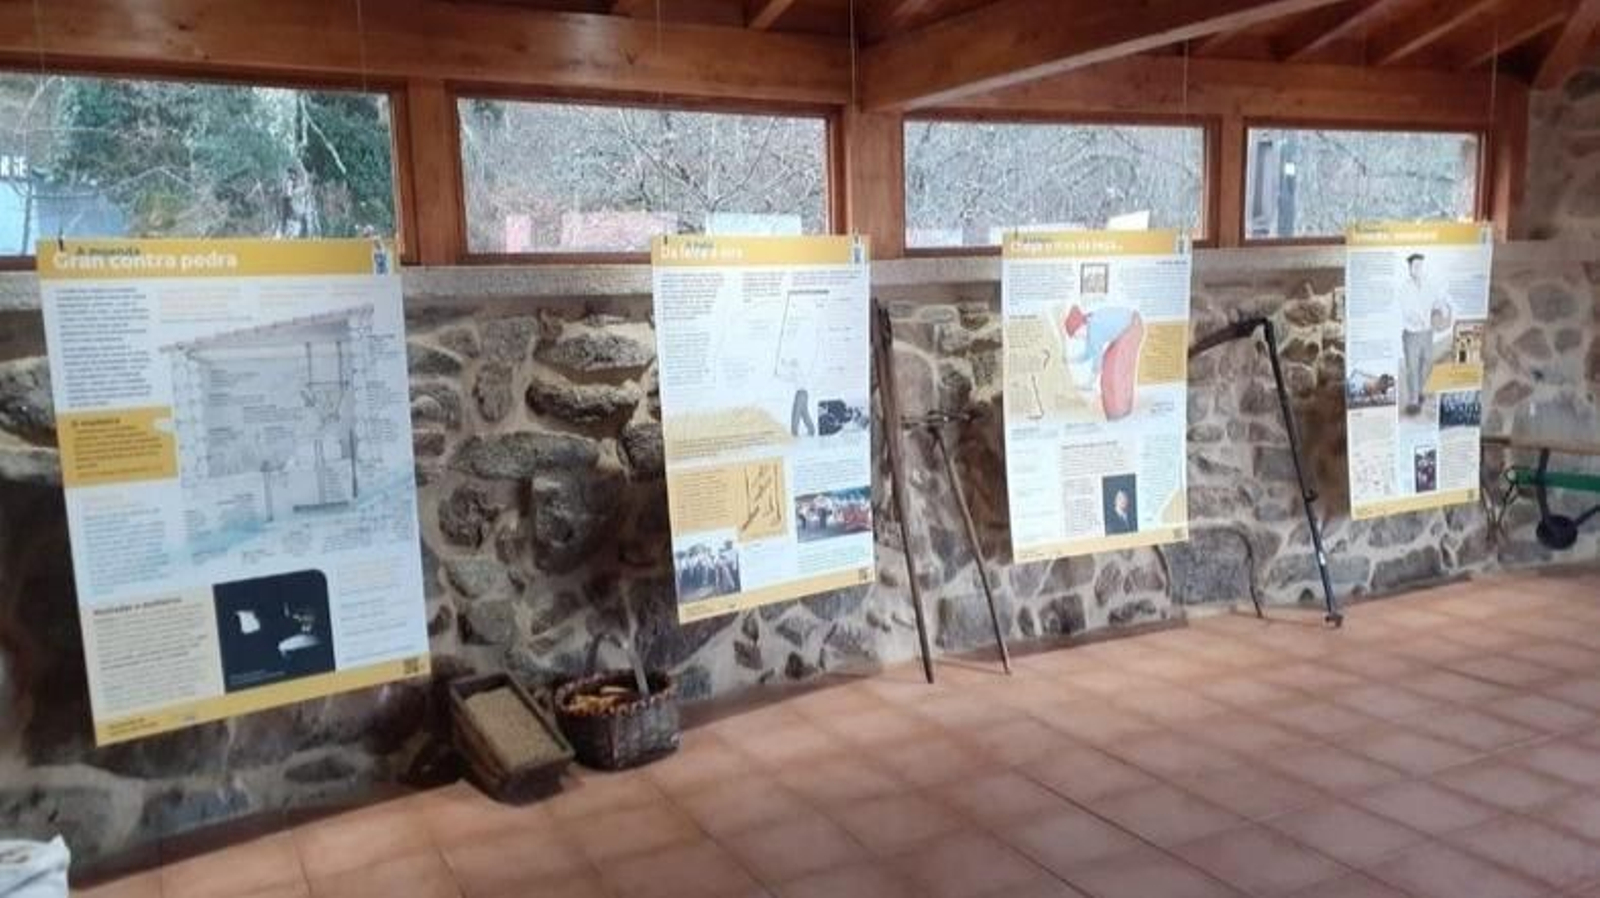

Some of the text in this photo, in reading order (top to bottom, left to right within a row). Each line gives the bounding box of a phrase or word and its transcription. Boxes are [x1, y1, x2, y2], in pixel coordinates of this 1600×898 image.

[53, 251, 238, 270] Gran contra pedra
